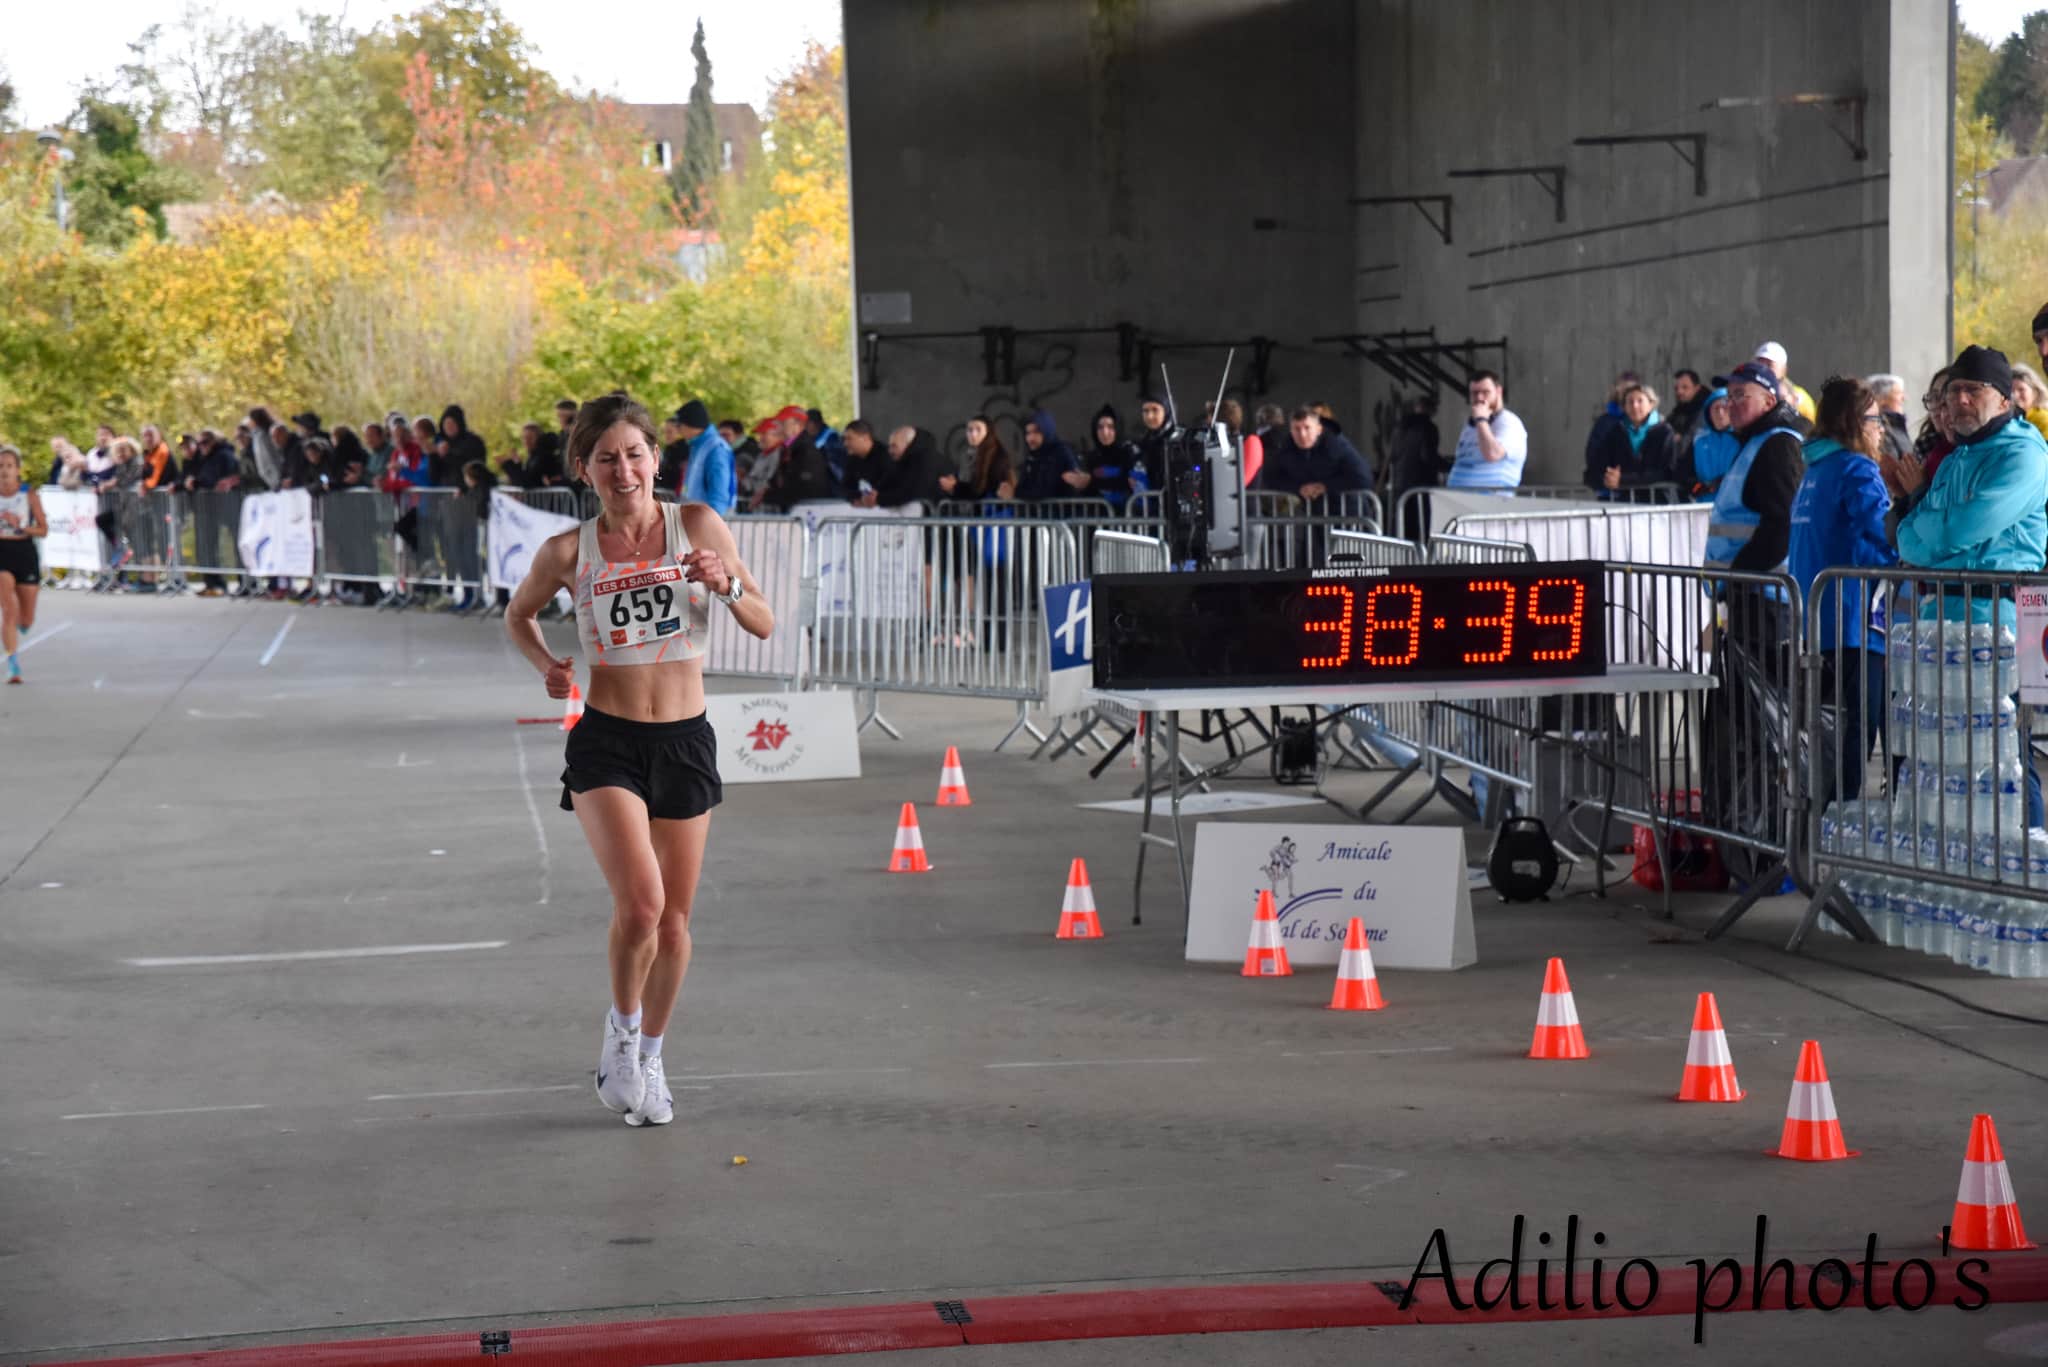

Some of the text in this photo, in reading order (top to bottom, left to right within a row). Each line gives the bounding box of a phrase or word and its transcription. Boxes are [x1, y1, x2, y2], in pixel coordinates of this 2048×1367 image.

[597, 570, 677, 593] LES 4 SAISONS
[1312, 567, 1390, 578] MATSPORT TIMING
[610, 584, 673, 627] 659
[741, 698, 788, 714] AMIENS
[1317, 840, 1392, 861] Amicale
[1353, 880, 1377, 900] du
[1280, 919, 1388, 941] al de Some
